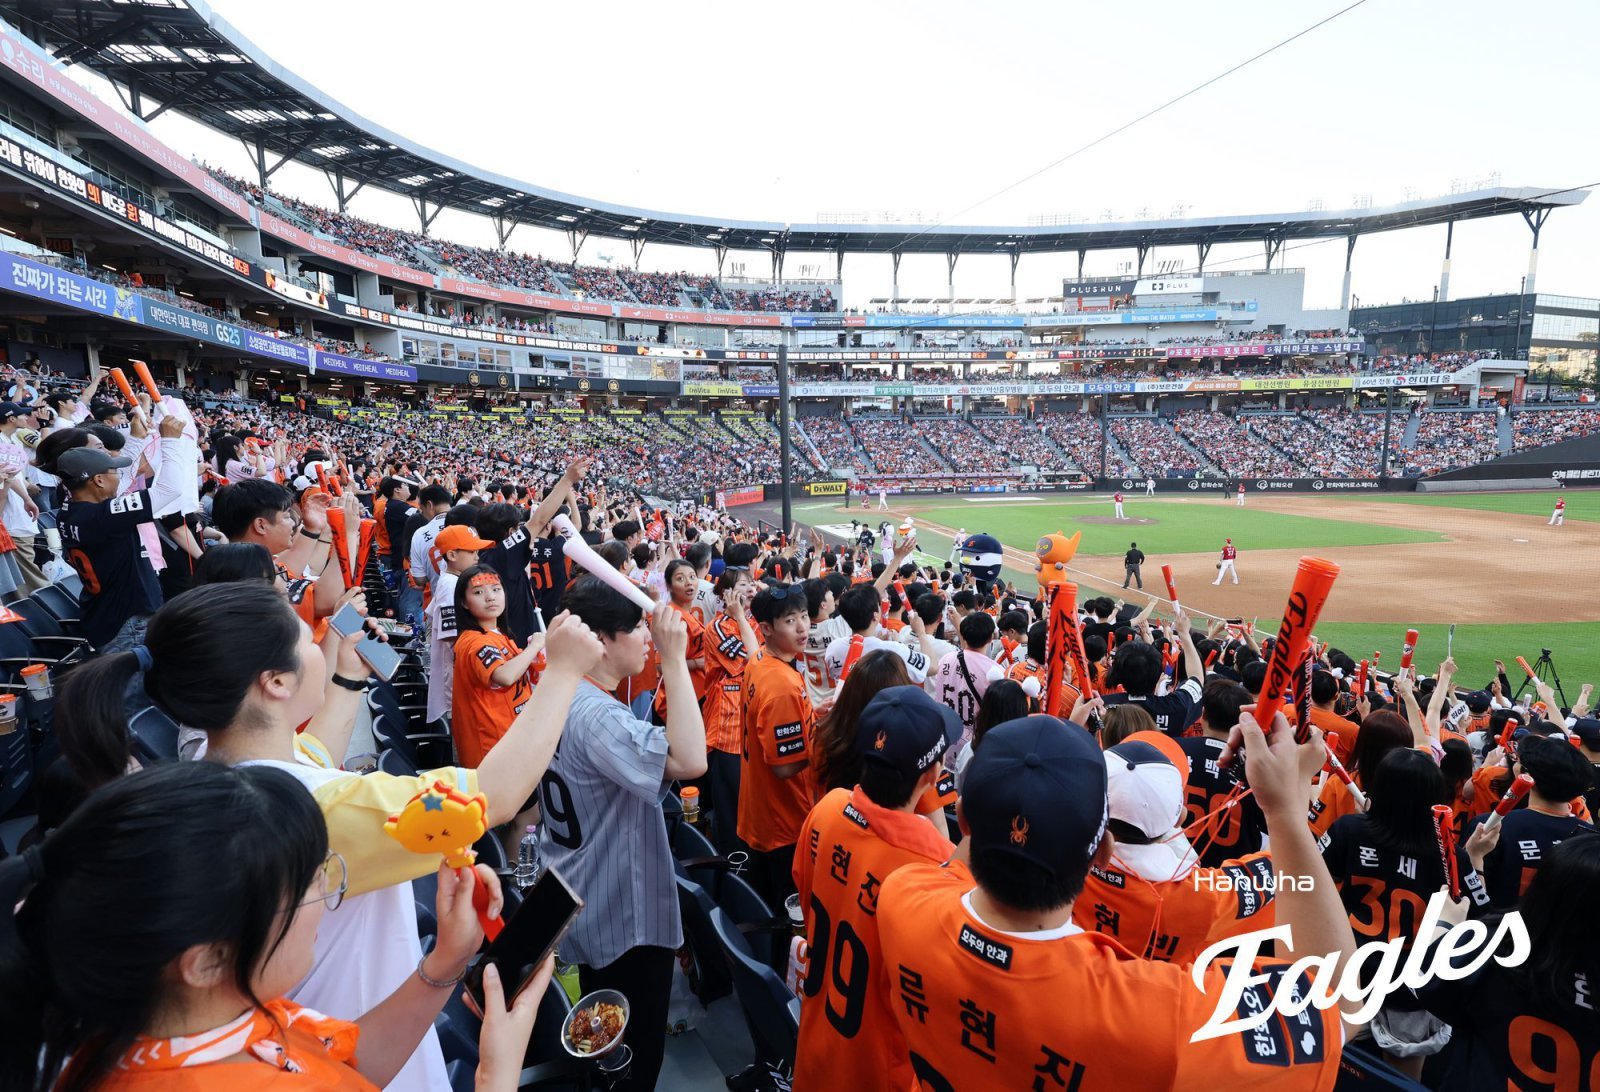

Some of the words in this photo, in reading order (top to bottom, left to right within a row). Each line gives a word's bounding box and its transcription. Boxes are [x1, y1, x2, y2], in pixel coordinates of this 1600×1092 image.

[12, 262, 54, 294] 진짜가
[57, 276, 82, 303] 되는
[84, 285, 108, 309] 시간
[1166, 282, 1188, 290] PLUS
[150, 306, 178, 326] 대한민국
[178, 316, 191, 329] 대표
[191, 320, 209, 335] 편의점
[216, 323, 241, 346] GS25
[1175, 346, 1219, 357] 포토카드는
[1224, 345, 1259, 355] 포토코드
[1273, 344, 1319, 354] 워터마크는
[1324, 343, 1361, 352] 스냅태그
[323, 357, 348, 369] MEDIHEAL
[353, 363, 378, 374] MEDIHEAL
[385, 367, 410, 378] MEDIHEAL
[1087, 384, 1112, 392] 모두의
[1113, 383, 1131, 391] 안과
[1255, 380, 1291, 388] 대전선병원
[1302, 379, 1340, 387] 유성선병원
[1362, 378, 1377, 386] 60년
[1038, 384, 1061, 393] 모두의
[1062, 384, 1080, 392] 안과
[1266, 591, 1309, 700] Eagles
[942, 683, 975, 726] 50
[776, 723, 801, 737] 한화오션
[1350, 874, 1428, 950] 30
[961, 929, 985, 954] 모두의
[986, 943, 1009, 964] 안과
